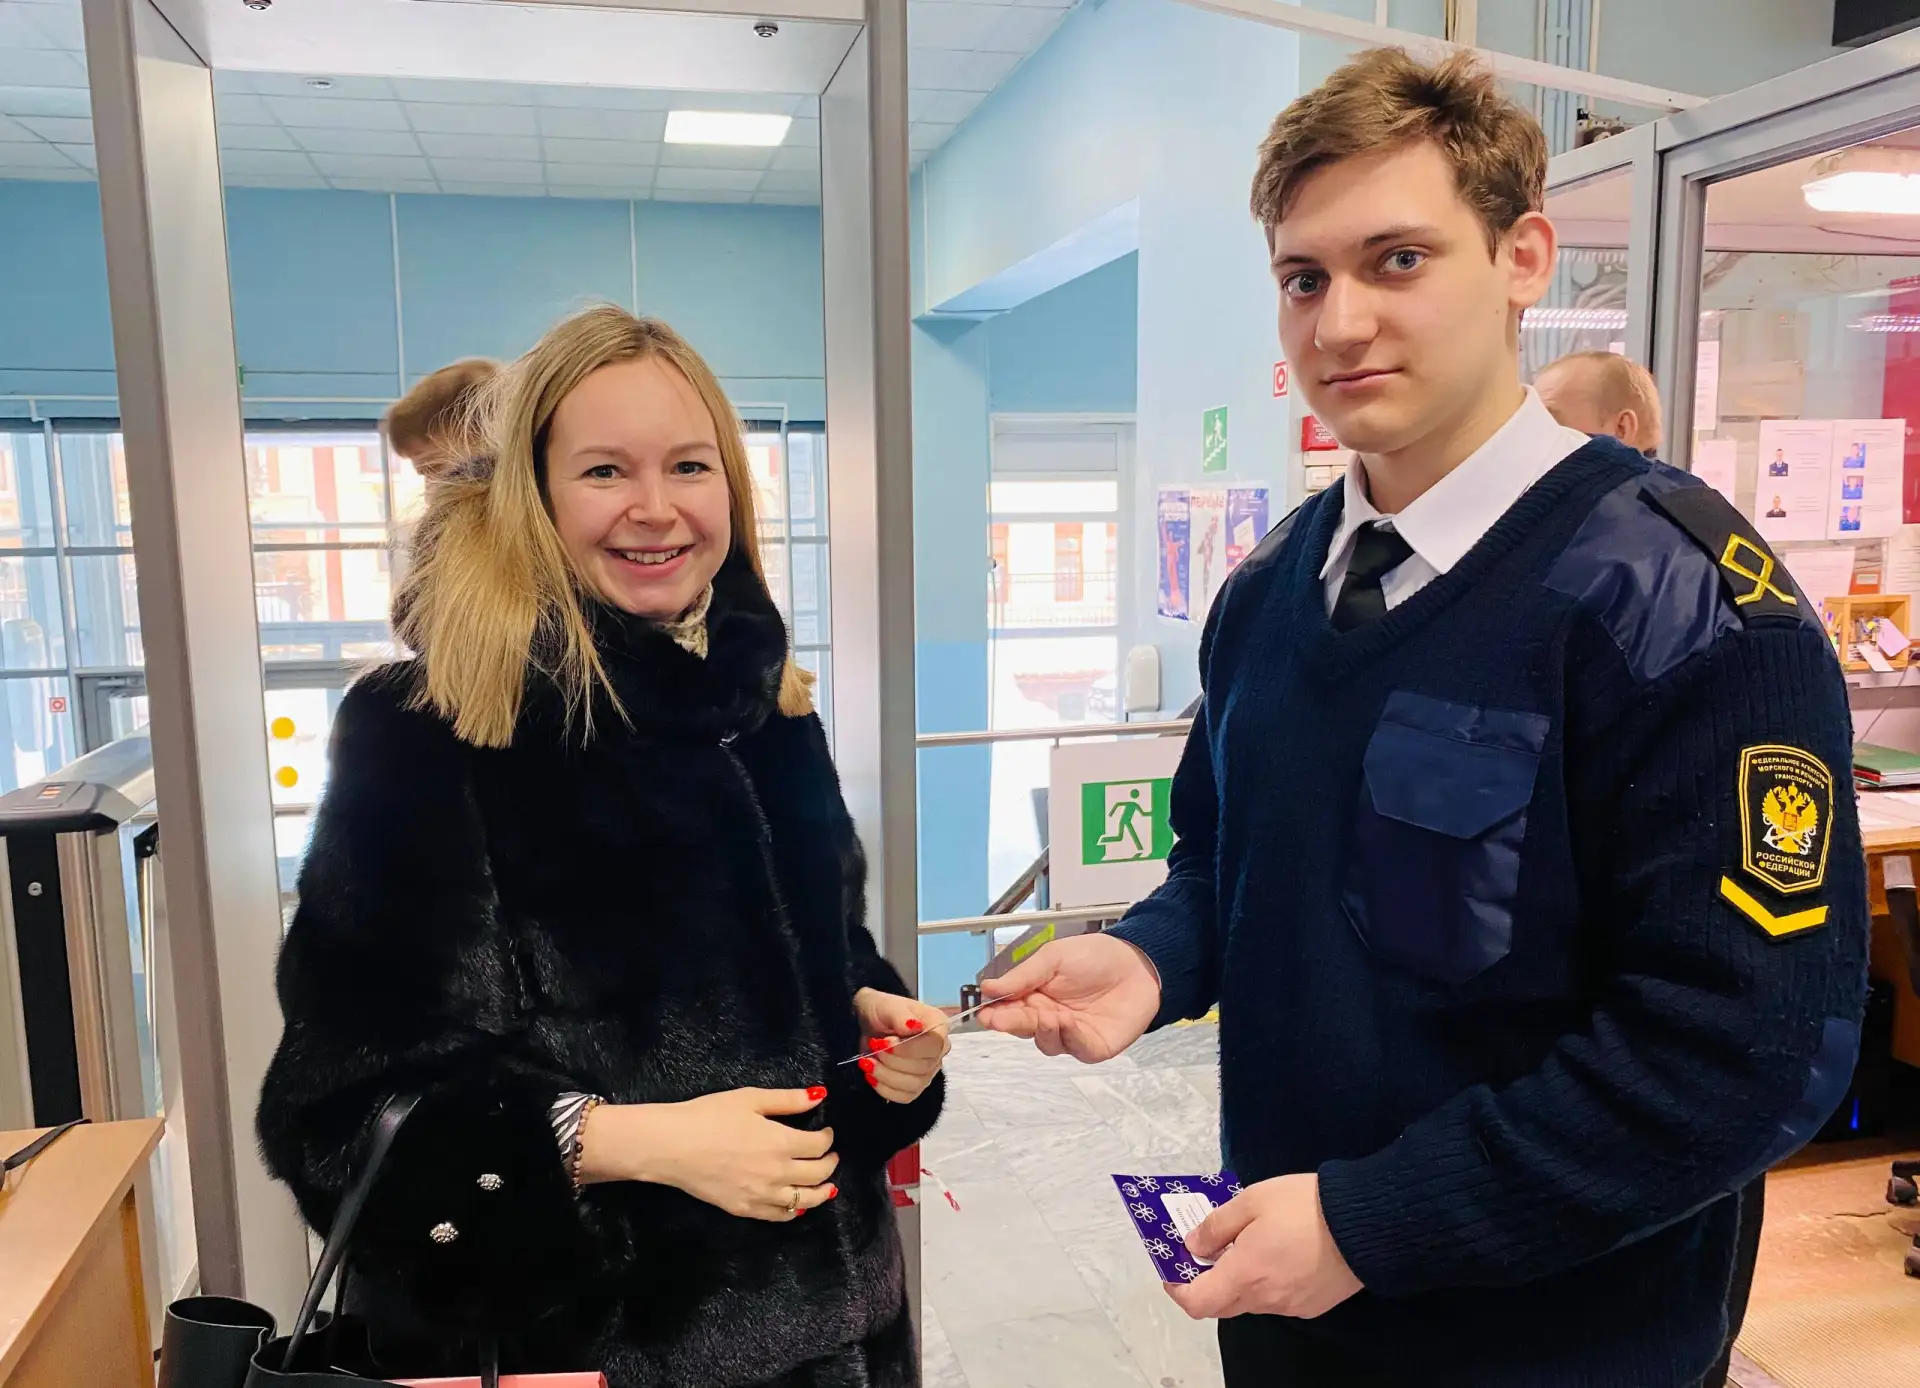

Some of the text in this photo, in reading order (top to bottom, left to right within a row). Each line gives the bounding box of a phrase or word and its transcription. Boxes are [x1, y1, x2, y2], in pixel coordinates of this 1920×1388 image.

[1752, 757, 1800, 766] ФЕДЕРАЛЬНОЕ
[1775, 773, 1813, 788] ТРАНСПОРТА
[1756, 852, 1815, 870] РОССИЙСКОЙ
[1758, 860, 1811, 878] ФЕДЕРАЦИИ
